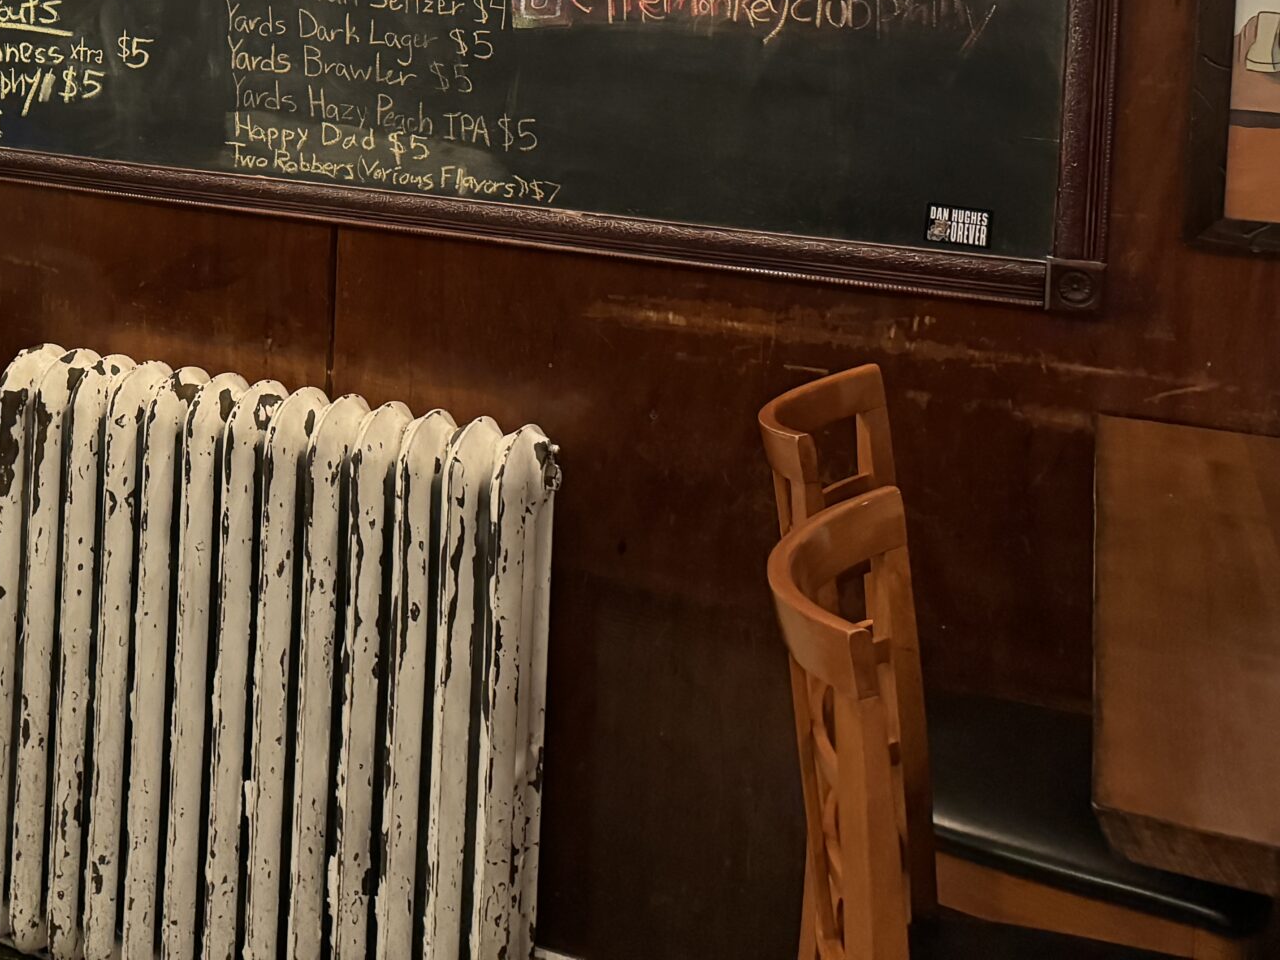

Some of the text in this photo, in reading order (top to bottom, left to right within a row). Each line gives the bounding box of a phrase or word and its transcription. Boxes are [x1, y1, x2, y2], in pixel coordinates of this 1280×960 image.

[117, 29, 155, 69] $5
[226, 0, 493, 60] Yards Dark $5
[58, 66, 105, 103] $5
[228, 37, 473, 93] Yards Brawler $5
[232, 73, 538, 153] Yards Hazy Peach IPA $5
[225, 141, 268, 168] Two
[274, 149, 355, 180] Robbers
[233, 111, 430, 165] Happy Dad $5
[930, 206, 989, 226] DAN HUGHES
